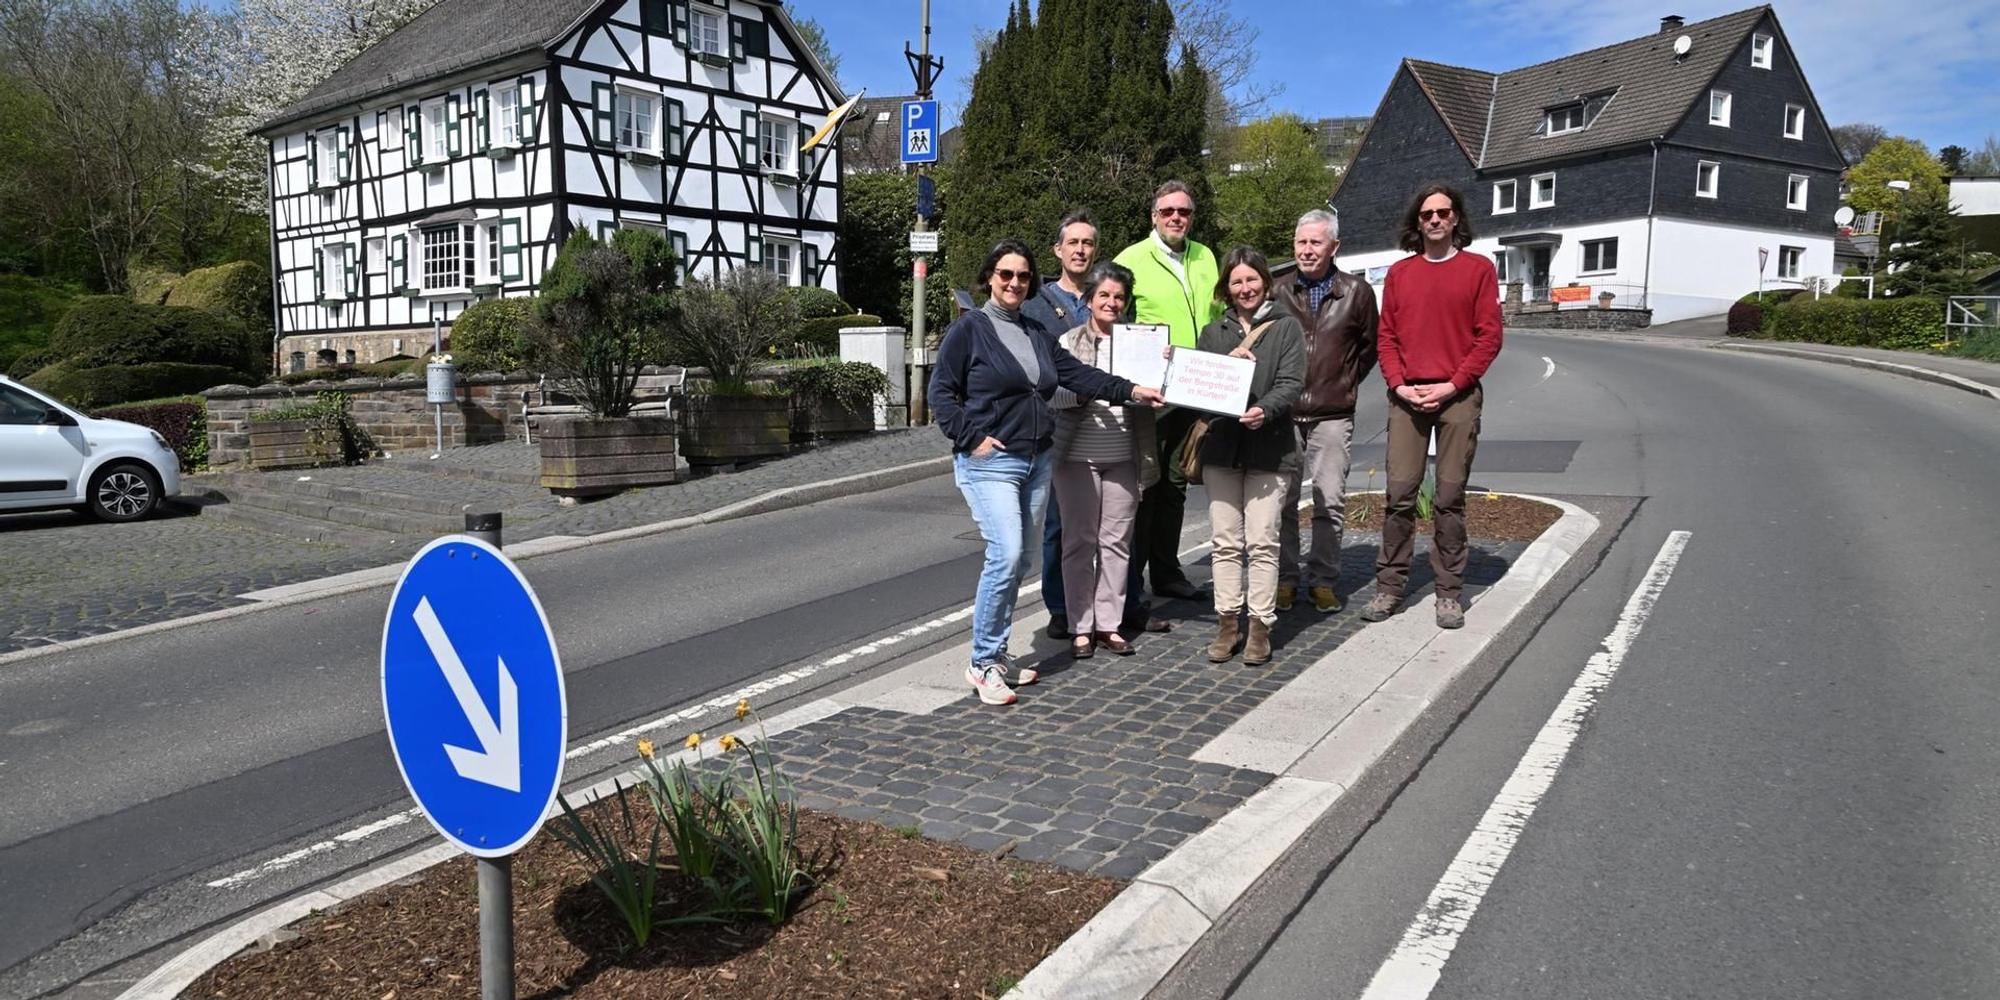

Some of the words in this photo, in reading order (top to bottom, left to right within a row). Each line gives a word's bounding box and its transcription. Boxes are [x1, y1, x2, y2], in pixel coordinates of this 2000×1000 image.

[908, 105, 923, 128] P
[1184, 365, 1212, 377] Tempo
[1178, 376, 1192, 384] der
